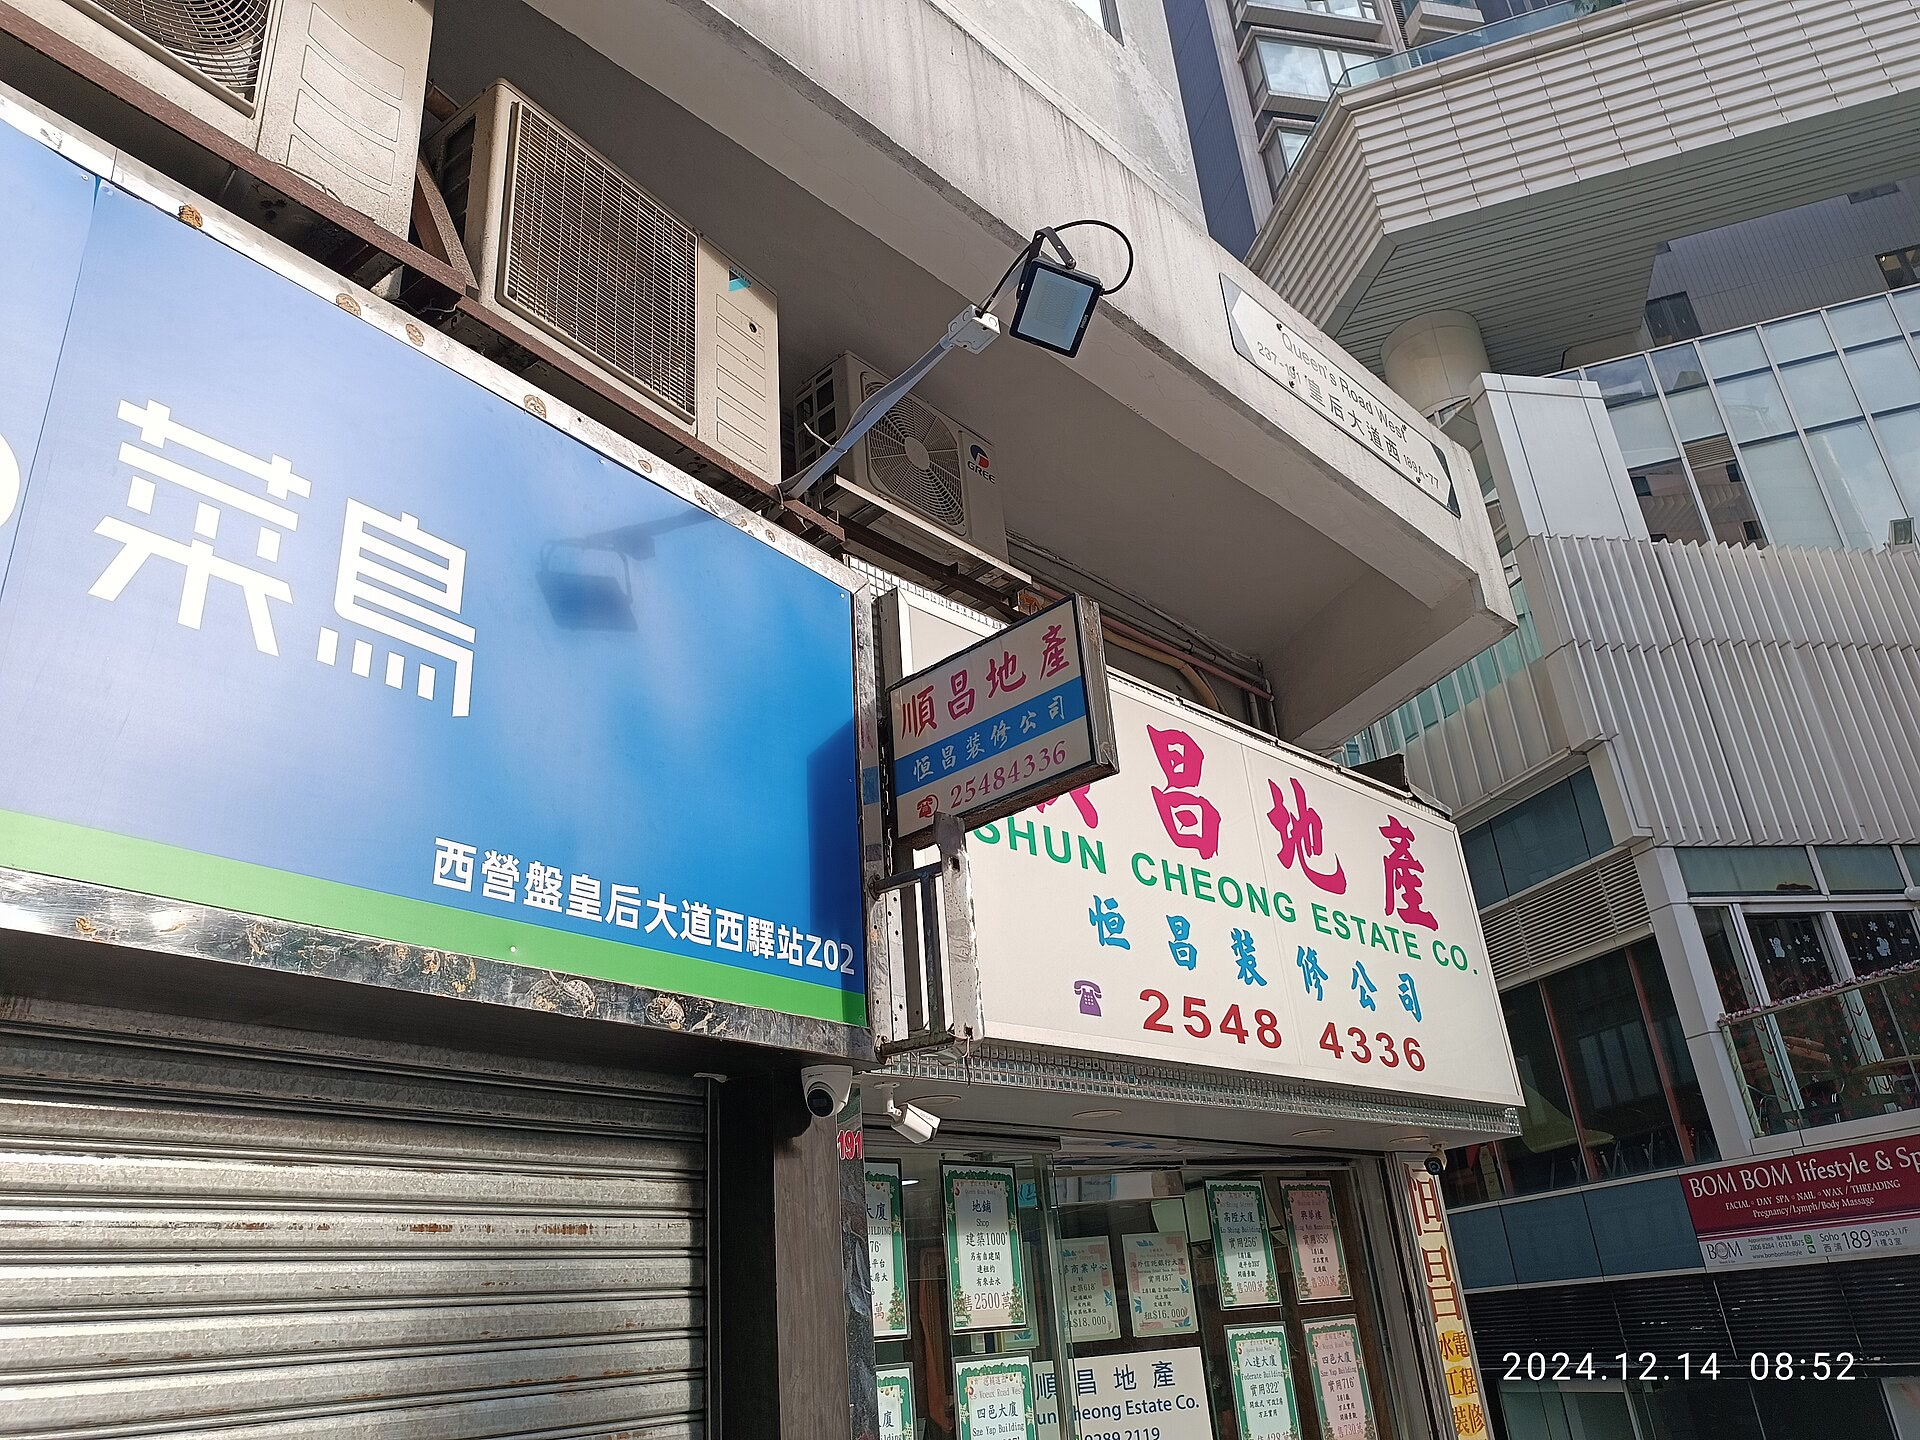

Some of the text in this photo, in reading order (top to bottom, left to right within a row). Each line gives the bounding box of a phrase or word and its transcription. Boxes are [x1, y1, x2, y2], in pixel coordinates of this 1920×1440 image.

[1281, 332, 1408, 444] Queen's Road West
[1304, 374, 1401, 464] 皇后大道西
[1403, 454, 1440, 489] 189A-77
[967, 460, 996, 485] GREE
[87, 398, 477, 718] 菜鳥
[901, 624, 1070, 739] 順昌地產
[950, 740, 1067, 809] 25484336
[1036, 725, 1438, 932] 昌地產
[432, 837, 856, 976] 西營盤皇后大道西驛站Z02
[1131, 852, 1298, 924] CHEONG
[1311, 902, 1421, 961] ESTATE
[1432, 940, 1479, 976] CO.
[1139, 988, 1426, 1073] 2548 4336
[837, 1130, 863, 1160] 191
[1688, 1172, 1738, 1198] BOM
[1739, 1163, 1793, 1191] BOM
[1795, 1152, 1871, 1183] lifestyle
[1875, 1150, 1893, 1171] &
[1725, 1200, 1750, 1211] FACIAL
[1756, 1196, 1772, 1206] DAY
[1776, 1194, 1790, 1204] SPA
[1796, 1190, 1816, 1201] NAIL
[1822, 1187, 1843, 1198] WAX
[1850, 1178, 1901, 1194] THREADING
[1841, 1196, 1875, 1208] Massage
[976, 1218, 990, 1229] Shop
[1819, 1232, 1840, 1242] Soho
[1871, 1228, 1890, 1238] Shop
[1841, 1229, 1872, 1249] 189
[1322, 1351, 1352, 1365] 四邑大廈
[1439, 1330, 1471, 1360] 水電
[1244, 1354, 1277, 1368] 八達大廈
[1444, 1366, 1478, 1396] 工程
[976, 1400, 1019, 1420] 四邑大廈
[1126, 1399, 1173, 1416] Estate
[1175, 1394, 1200, 1410] Co.
[1453, 1402, 1485, 1435] 裝修
[973, 1423, 1025, 1437] Sze Yap Building
